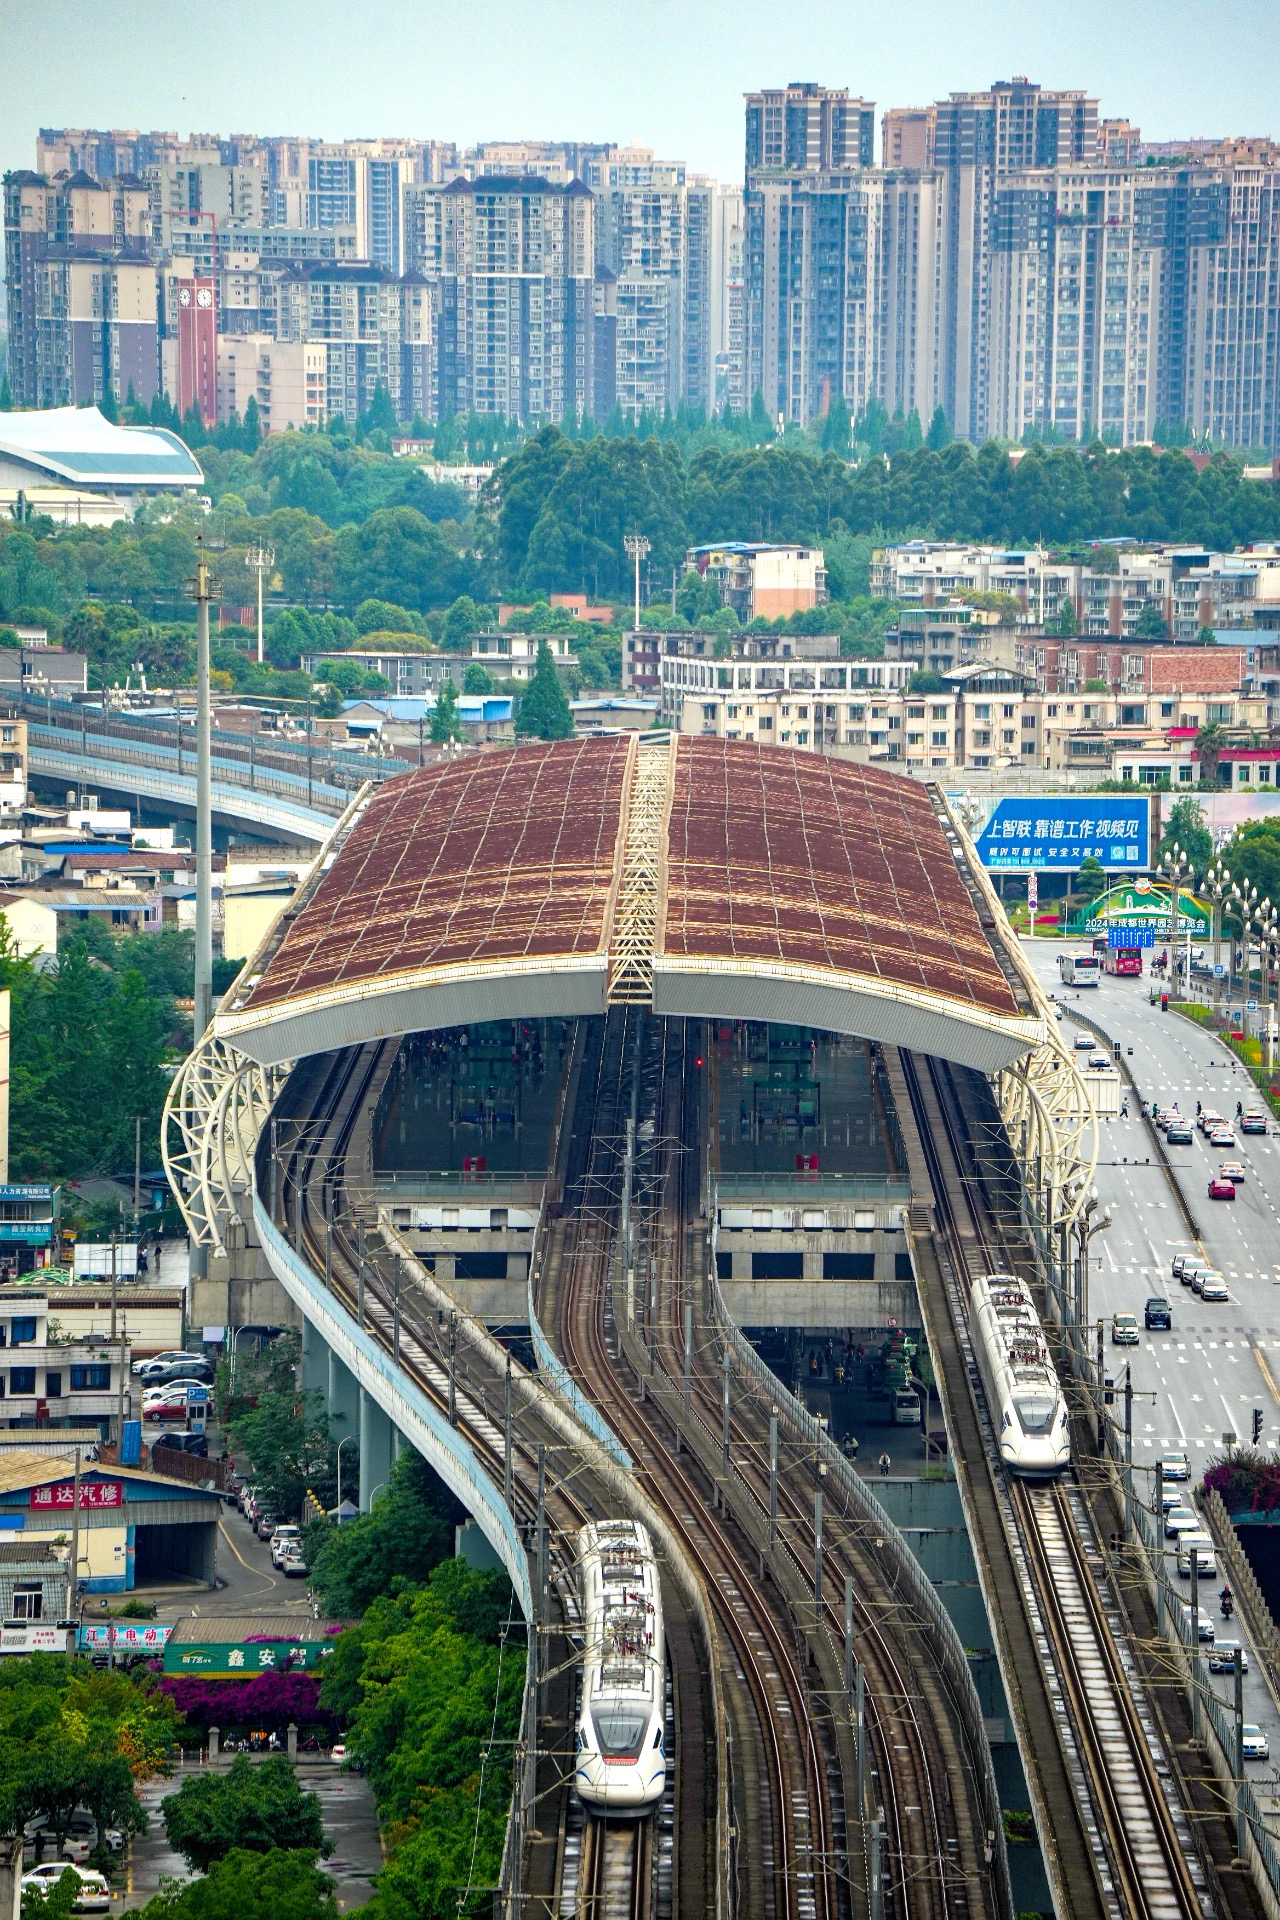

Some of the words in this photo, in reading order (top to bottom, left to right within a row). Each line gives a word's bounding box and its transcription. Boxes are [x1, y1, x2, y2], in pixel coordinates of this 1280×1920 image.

[188, 1389, 196, 1400] P
[34, 1484, 118, 1504] 通达汽修
